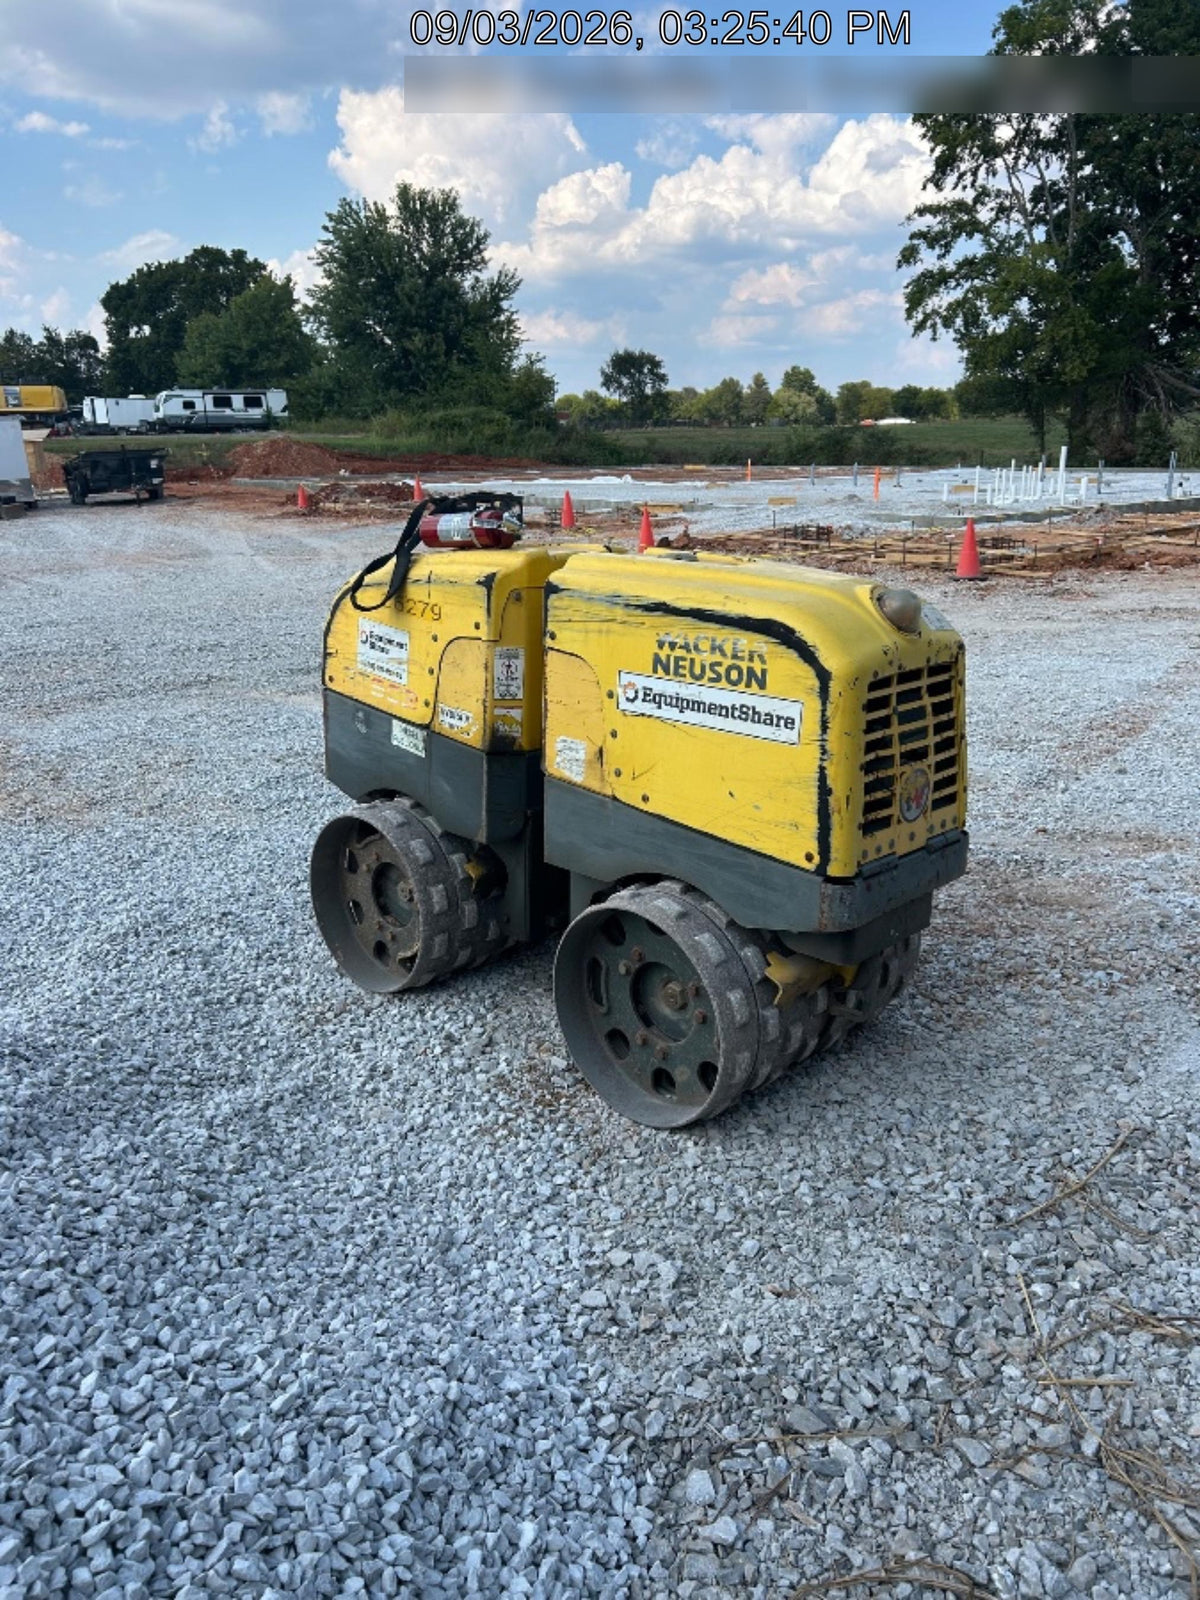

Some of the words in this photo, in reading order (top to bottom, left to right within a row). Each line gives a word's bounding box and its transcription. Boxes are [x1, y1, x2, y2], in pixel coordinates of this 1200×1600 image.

[656, 632, 768, 665] WACKER
[652, 652, 768, 690] NEUSON
[641, 686, 796, 730] EquipmentShare
